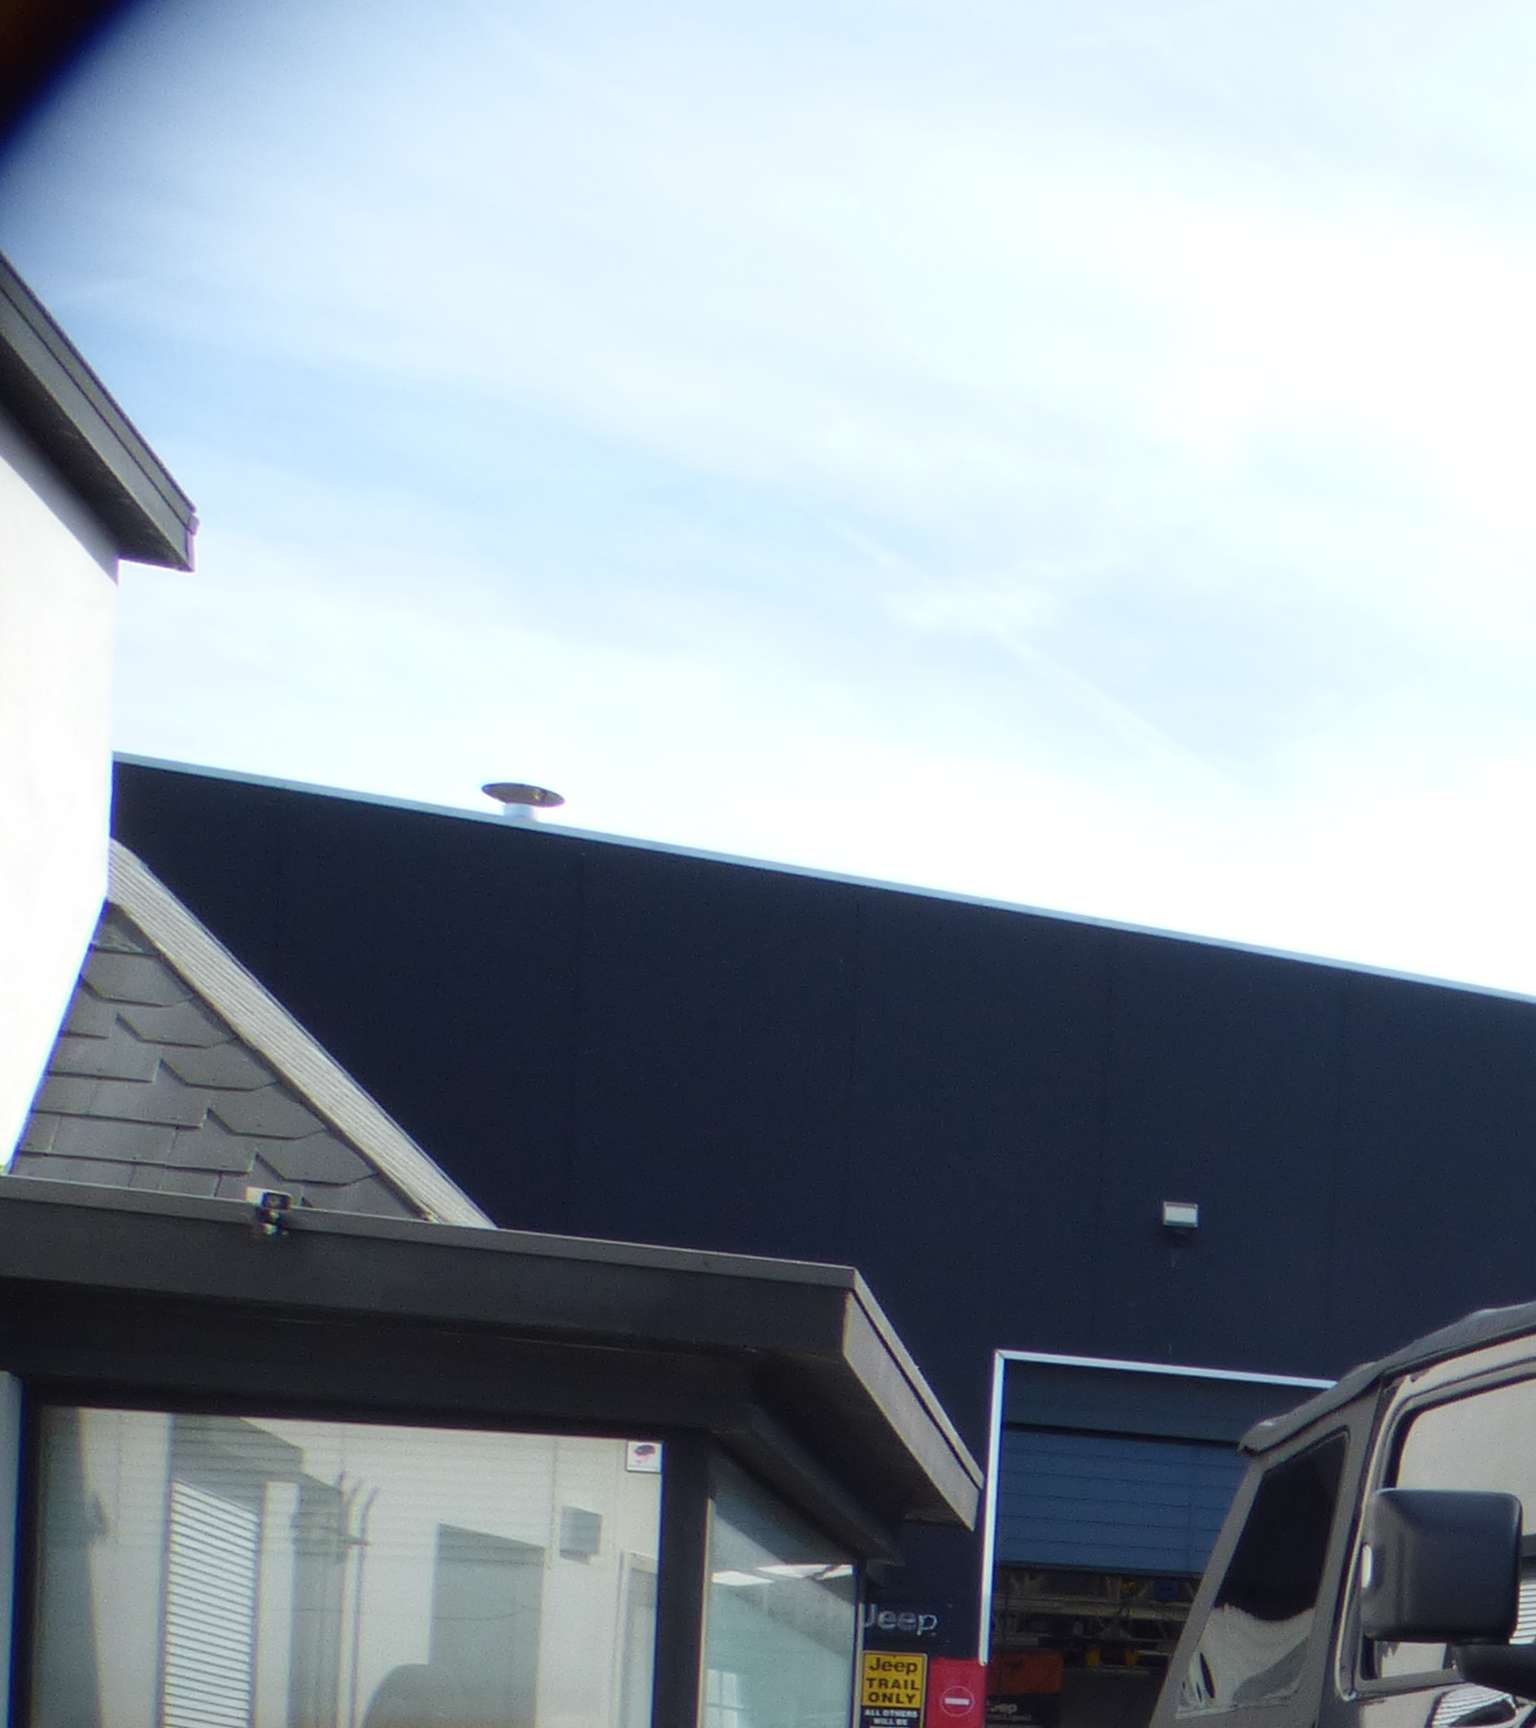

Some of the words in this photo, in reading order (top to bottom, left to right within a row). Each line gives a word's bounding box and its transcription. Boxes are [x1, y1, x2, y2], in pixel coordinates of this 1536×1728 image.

[870, 1657, 918, 1674] Jeep
[866, 1678, 919, 1691] TRAIL
[868, 1692, 916, 1704] ONLY
